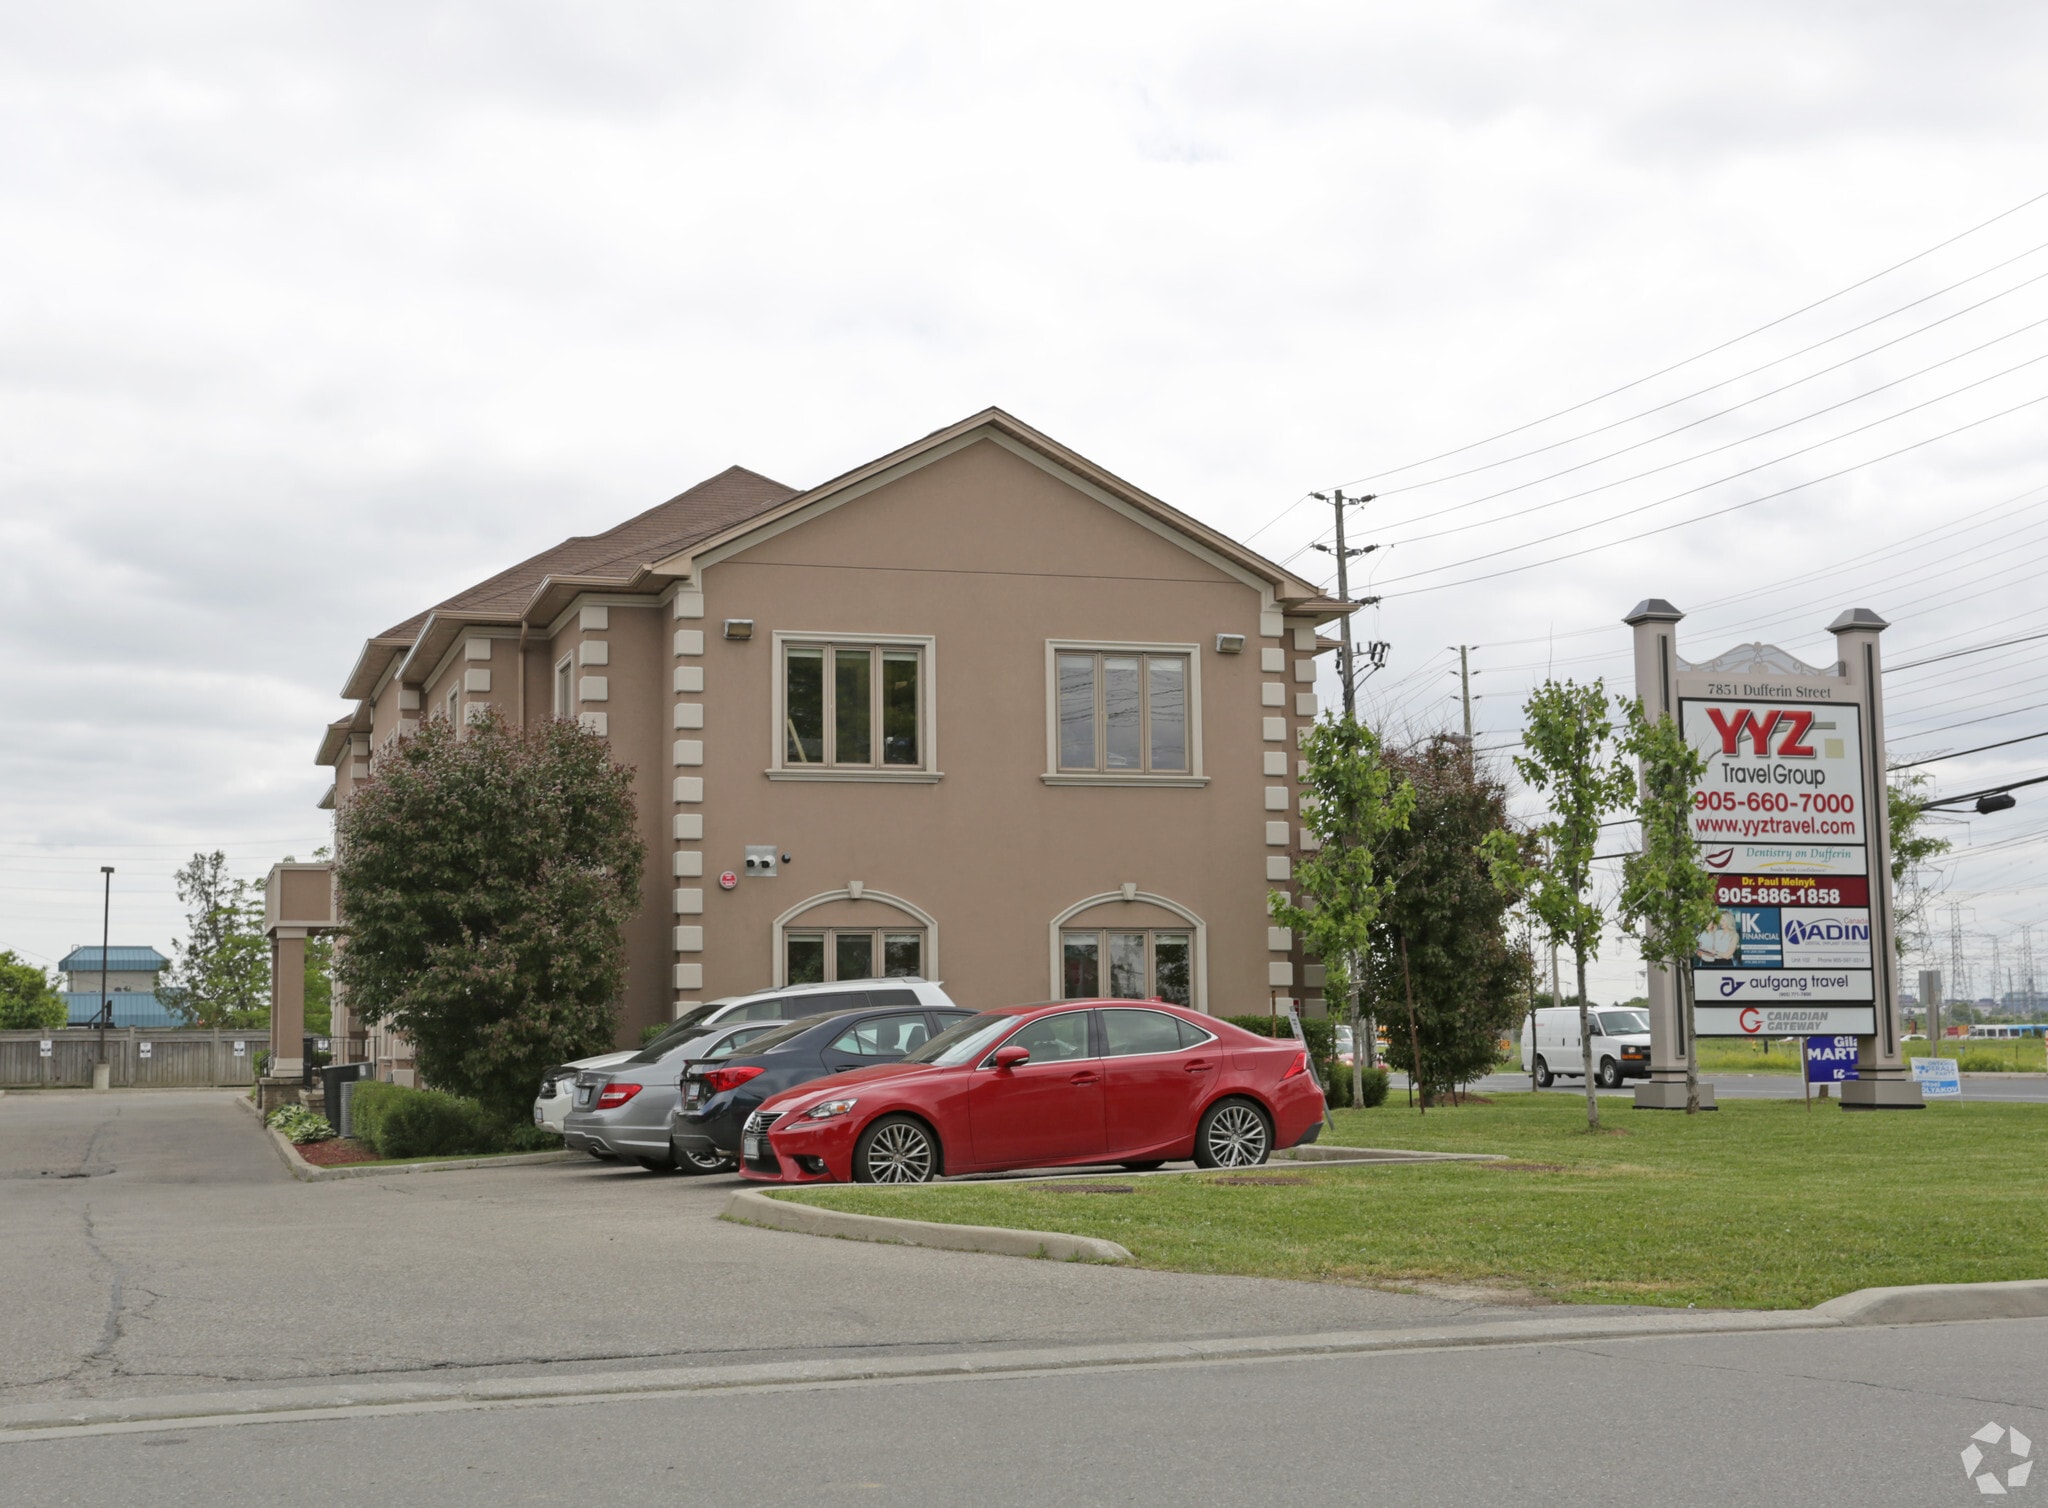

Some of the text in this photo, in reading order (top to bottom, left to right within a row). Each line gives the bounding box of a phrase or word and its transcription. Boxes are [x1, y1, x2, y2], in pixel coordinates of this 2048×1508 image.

[1708, 683, 1831, 698] 7851 Dufferin Street
[1705, 707, 1815, 758] YYZ
[1722, 762, 1825, 788] Travel Group
[1695, 791, 1854, 813] 905-660-7000
[1696, 817, 1855, 836] www.yyztravel.com
[1746, 847, 1851, 863] Dentistry on Dufferin
[1742, 877, 1815, 888] Dr. Paul Melnyk
[1718, 887, 1840, 904] 905-886-1858
[1806, 925, 1869, 940] ADIN
[1750, 975, 1848, 991] aufgang travel
[1767, 1011, 1829, 1021] CANADIAN
[1767, 1022, 1822, 1031] GATEWAY
